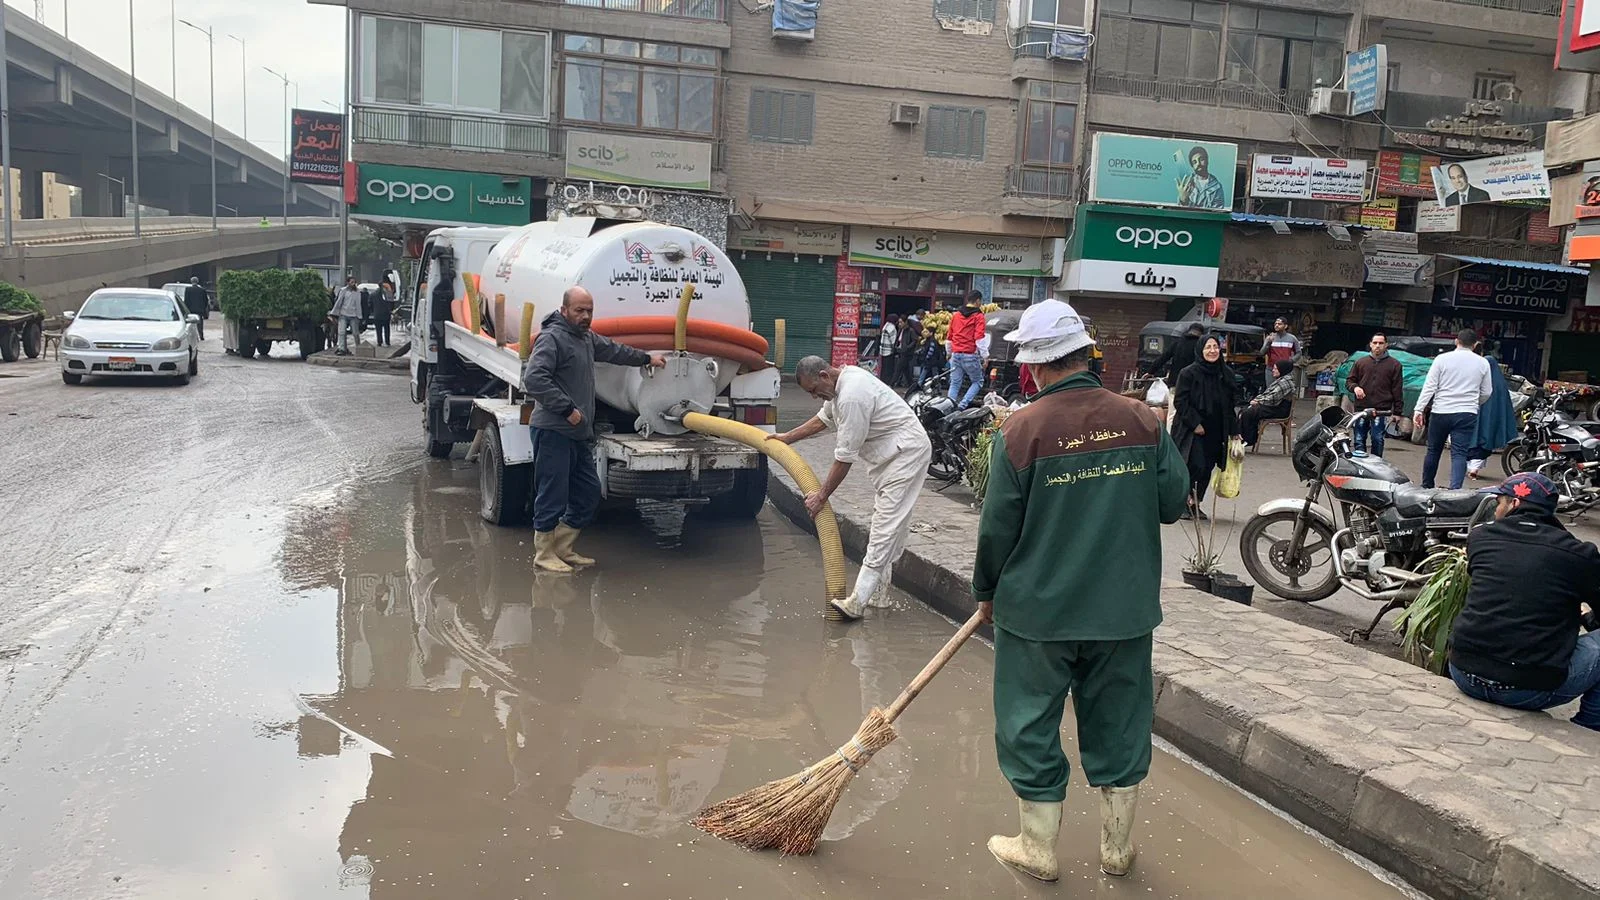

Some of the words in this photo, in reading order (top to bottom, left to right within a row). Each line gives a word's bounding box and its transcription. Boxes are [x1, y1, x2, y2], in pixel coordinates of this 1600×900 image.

[310, 119, 340, 131] معمل
[294, 131, 340, 150] المعز
[578, 145, 613, 160] scib
[1108, 158, 1133, 169] OPPO
[1135, 160, 1162, 171] Reno6
[1511, 172, 1531, 184] الفتاح
[1532, 173, 1542, 181] عبد
[366, 179, 455, 204] oppo
[477, 193, 525, 206] كلاسيك
[875, 236, 913, 252] scib
[1116, 226, 1193, 249] oppo
[893, 252, 913, 260] Paints
[980, 254, 1008, 263] الإسلام
[1010, 255, 1023, 264] لواء
[609, 266, 647, 287] والتجميل
[650, 266, 678, 282] للنظافة
[681, 267, 702, 284] العامة
[1125, 267, 1177, 291] دبشه
[1495, 268, 1569, 293] قطونيل
[1495, 294, 1561, 309] COTTONIL
[1058, 434, 1086, 449] الجيزة
[1090, 428, 1127, 441] محافظة
[1078, 467, 1100, 480] للنظافة
